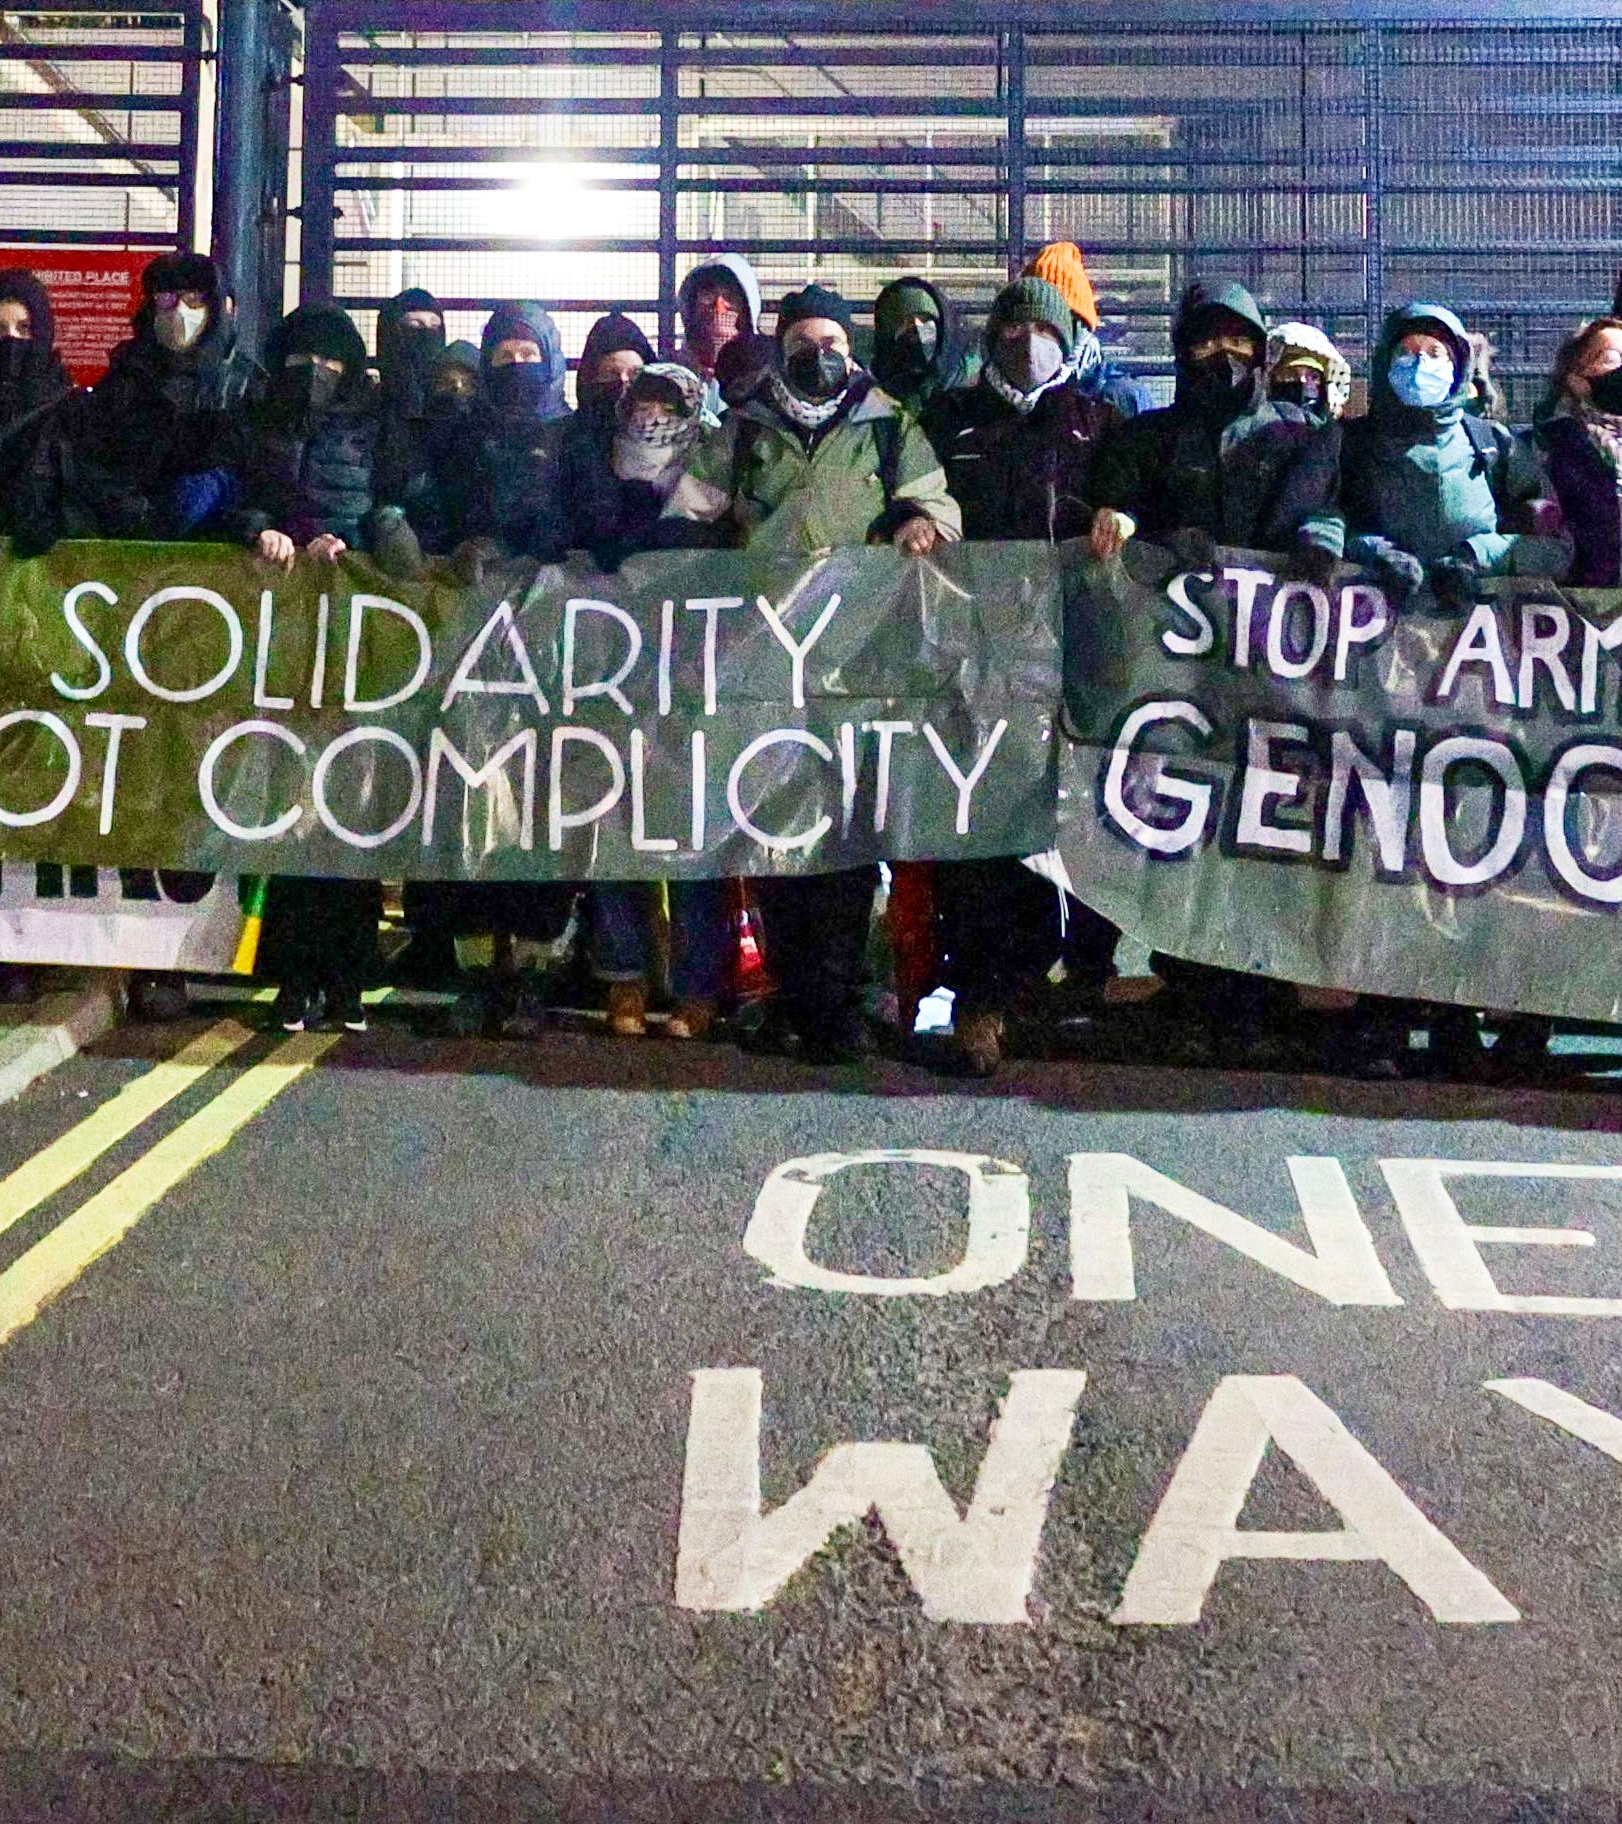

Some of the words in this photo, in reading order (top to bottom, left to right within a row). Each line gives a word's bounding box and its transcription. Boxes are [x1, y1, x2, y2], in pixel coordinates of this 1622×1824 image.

[49, 581, 842, 717] SOLIDARITY
[1161, 567, 1387, 681] STOP
[198, 718, 1008, 853] COMPLICITY
